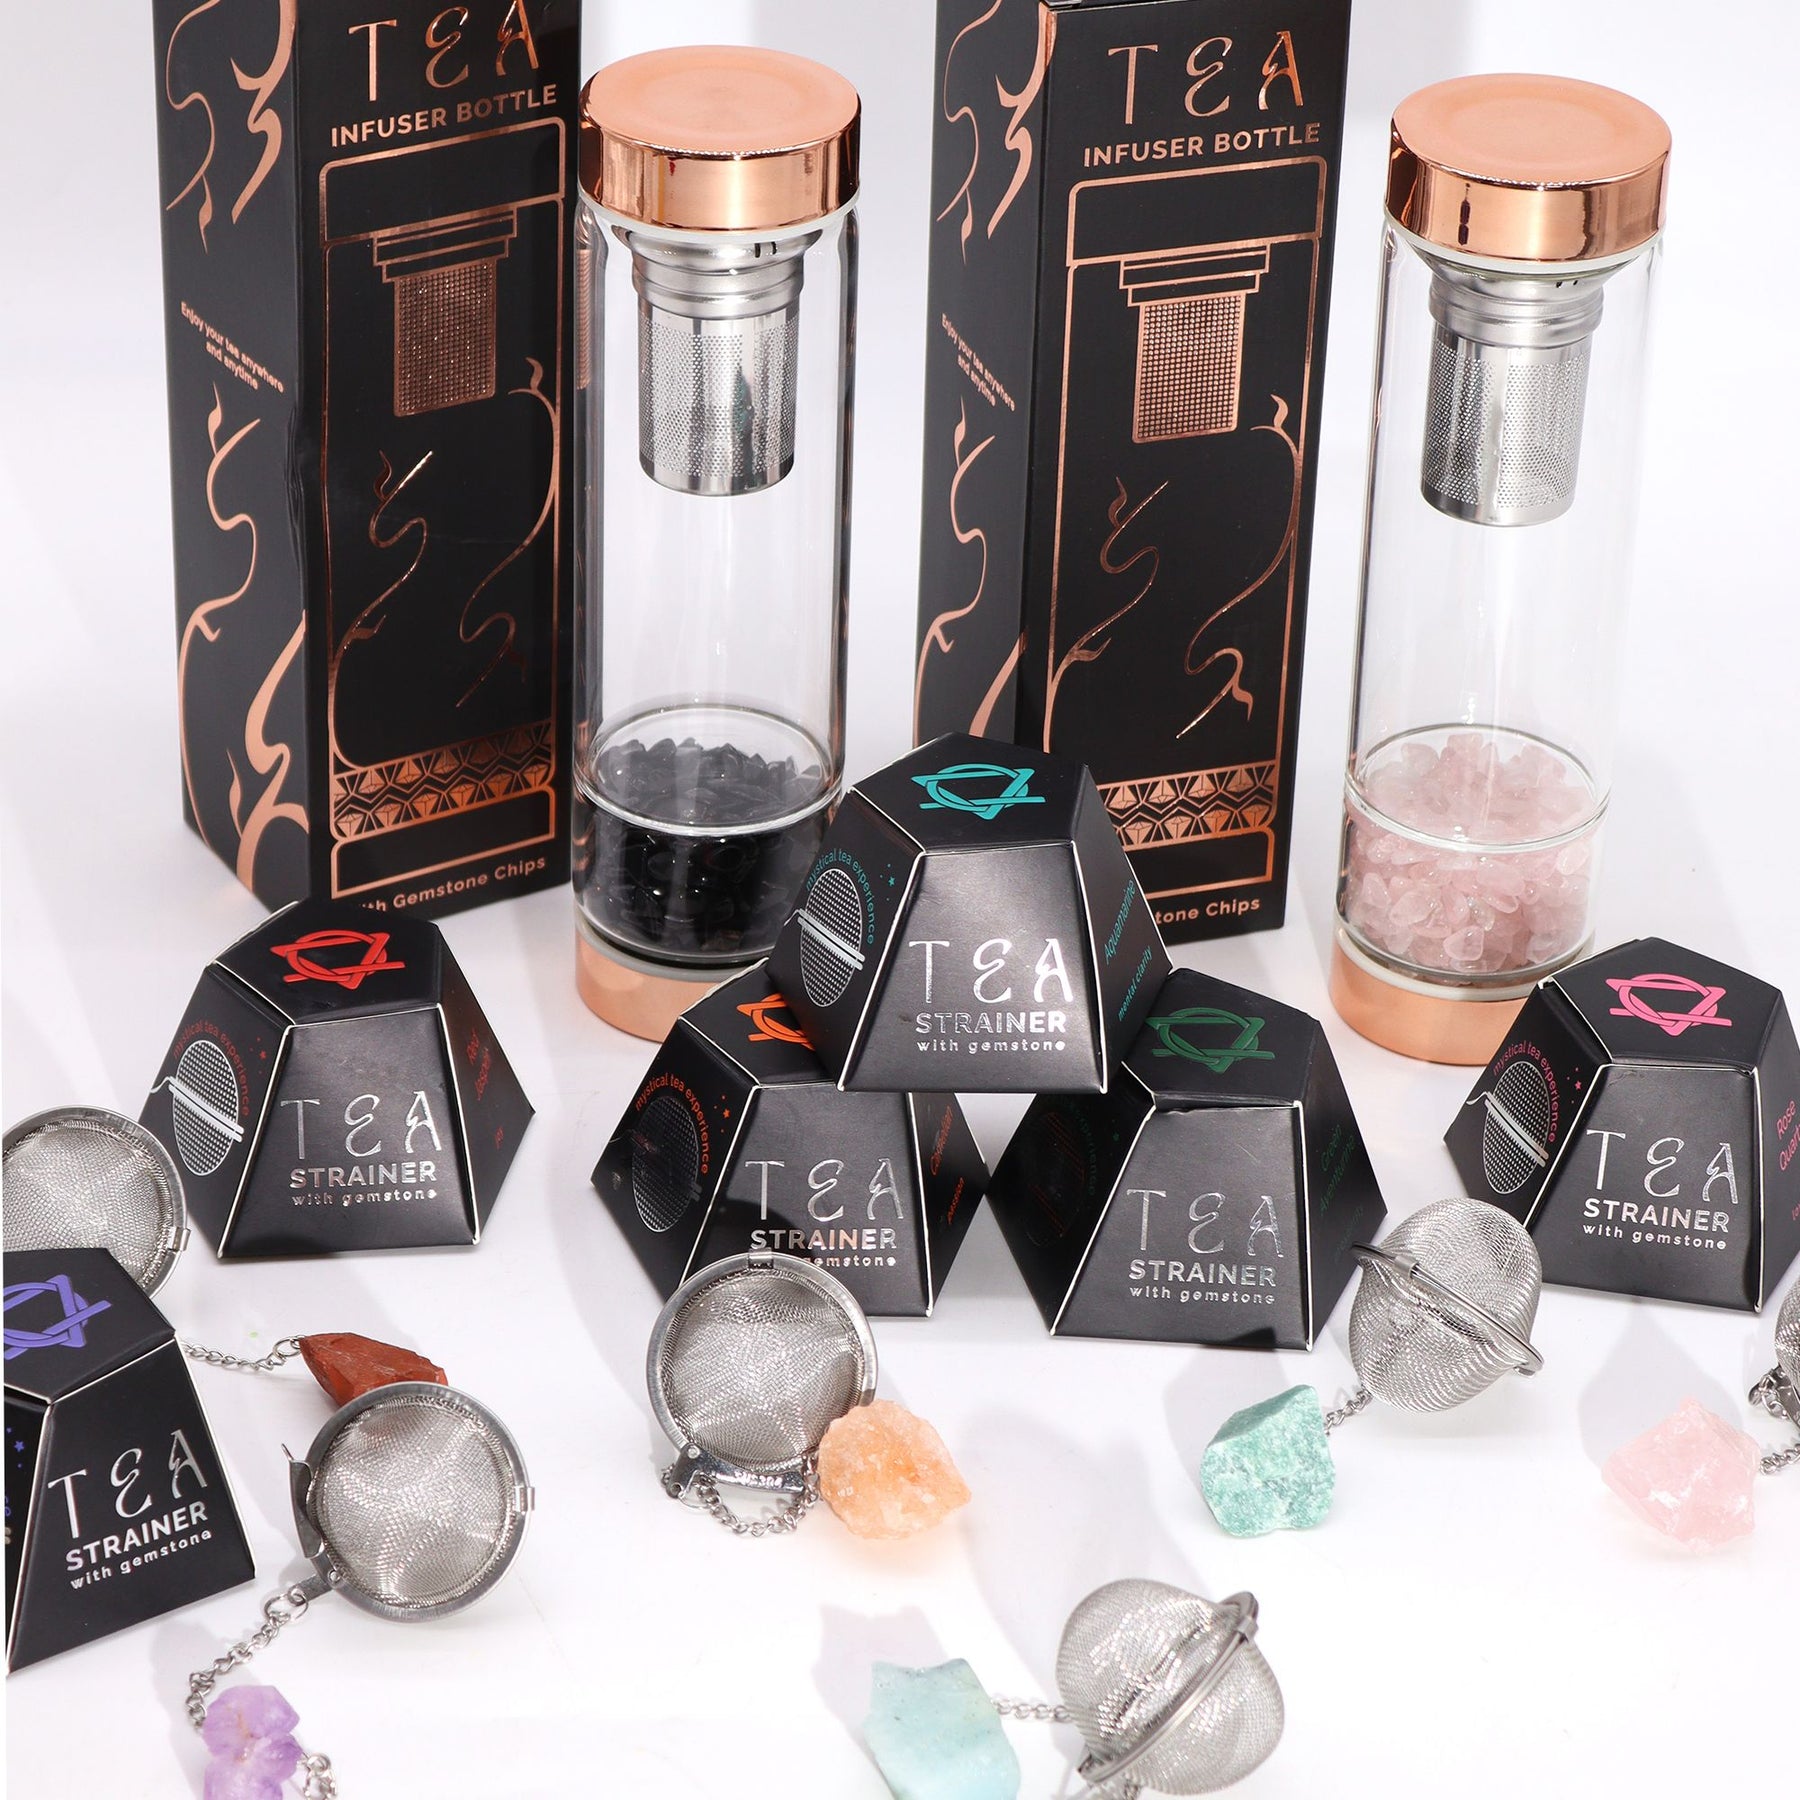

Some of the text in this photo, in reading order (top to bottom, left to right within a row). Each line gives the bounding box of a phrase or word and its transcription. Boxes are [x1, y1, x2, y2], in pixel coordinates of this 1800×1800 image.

[348, 0, 538, 102] TEA
[1108, 30, 1303, 124] TEA
[331, 84, 557, 147] INFUSER BOTTLE
[1084, 122, 1320, 167] INFUSER BOTTLE
[180, 301, 284, 393] Enjoy your tea anywhere
[206, 341, 258, 390] and anytime
[393, 873, 488, 909] Gemstone
[494, 856, 546, 880] Chips
[806, 847, 876, 944] mystical tea experience
[1156, 898, 1261, 924] tone Chips
[1104, 879, 1136, 965] Aquamarine
[909, 938, 1073, 1003] TEA
[915, 1010, 1067, 1034] STRAINER
[917, 1038, 1066, 1054] with gemstone
[1493, 1040, 1560, 1142] mystical tea experience
[1777, 1100, 1796, 1140] Rose
[281, 1090, 442, 1160] TEA
[635, 1072, 710, 1174] mystical tea experience
[1779, 1122, 1800, 1171] Quart
[290, 1160, 437, 1189] STRAINER
[745, 1158, 903, 1222] TEA
[1586, 1129, 1738, 1204] TEA
[292, 1188, 438, 1207] with gemstone
[1127, 1188, 1284, 1258] TEA
[1583, 1197, 1730, 1232] STRAINER
[750, 1228, 897, 1250] STRAINER
[1582, 1223, 1727, 1250] with gemstone
[1129, 1258, 1276, 1287] STRAINER
[1129, 1286, 1275, 1305] with gemstone
[47, 1429, 208, 1539] TEA
[65, 1500, 208, 1571] STRAINER
[70, 1529, 212, 1589] with gemstone
